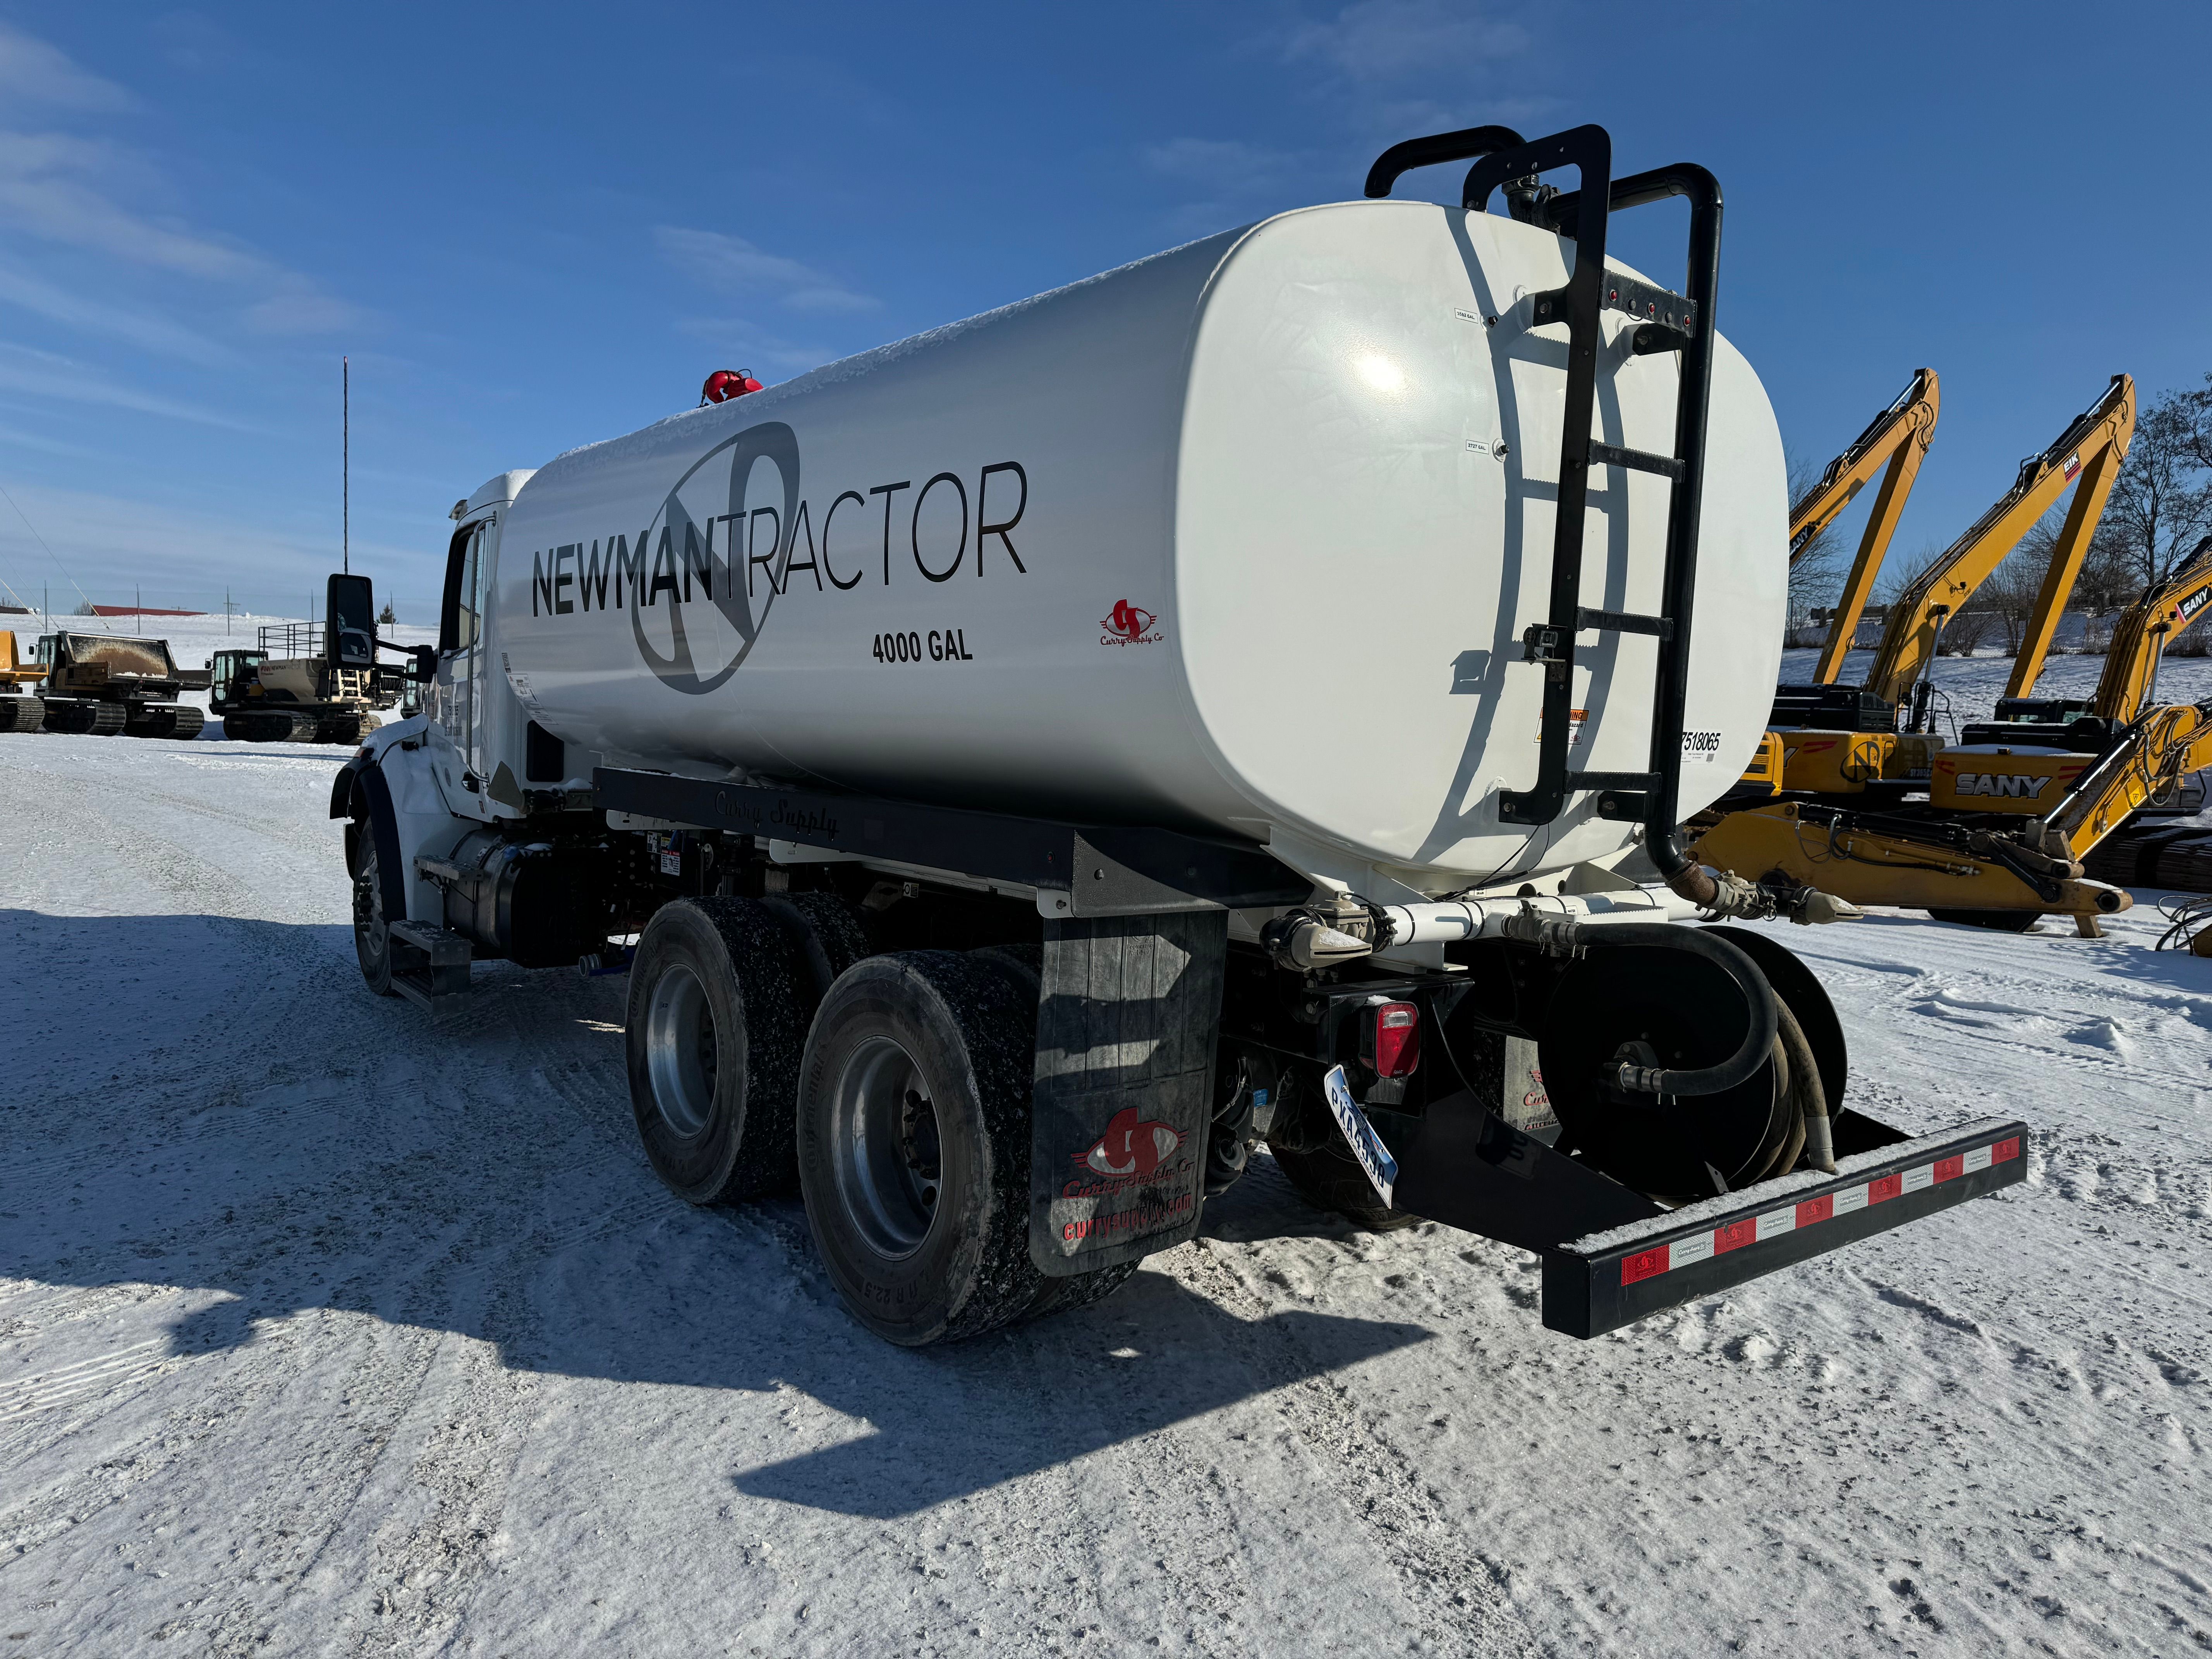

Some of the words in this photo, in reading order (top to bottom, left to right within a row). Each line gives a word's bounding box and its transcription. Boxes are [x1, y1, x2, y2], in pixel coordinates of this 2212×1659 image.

[2063, 450, 2078, 472] EIK
[2183, 587, 2208, 616] SANY
[873, 632, 921, 663] 4000
[928, 629, 973, 661] GAL
[1100, 635, 1127, 647] Curry
[1127, 634, 1152, 644] Supply
[1682, 732, 1721, 751] 7518065
[1956, 773, 2053, 799] SANY
[715, 790, 763, 830] Curry
[770, 799, 840, 843] Supply
[803, 1051, 825, 1173] Continental
[1523, 1092, 1549, 1106] Cur
[1331, 1087, 1386, 1188] PXA4538
[1062, 1180, 1125, 1199] Curry
